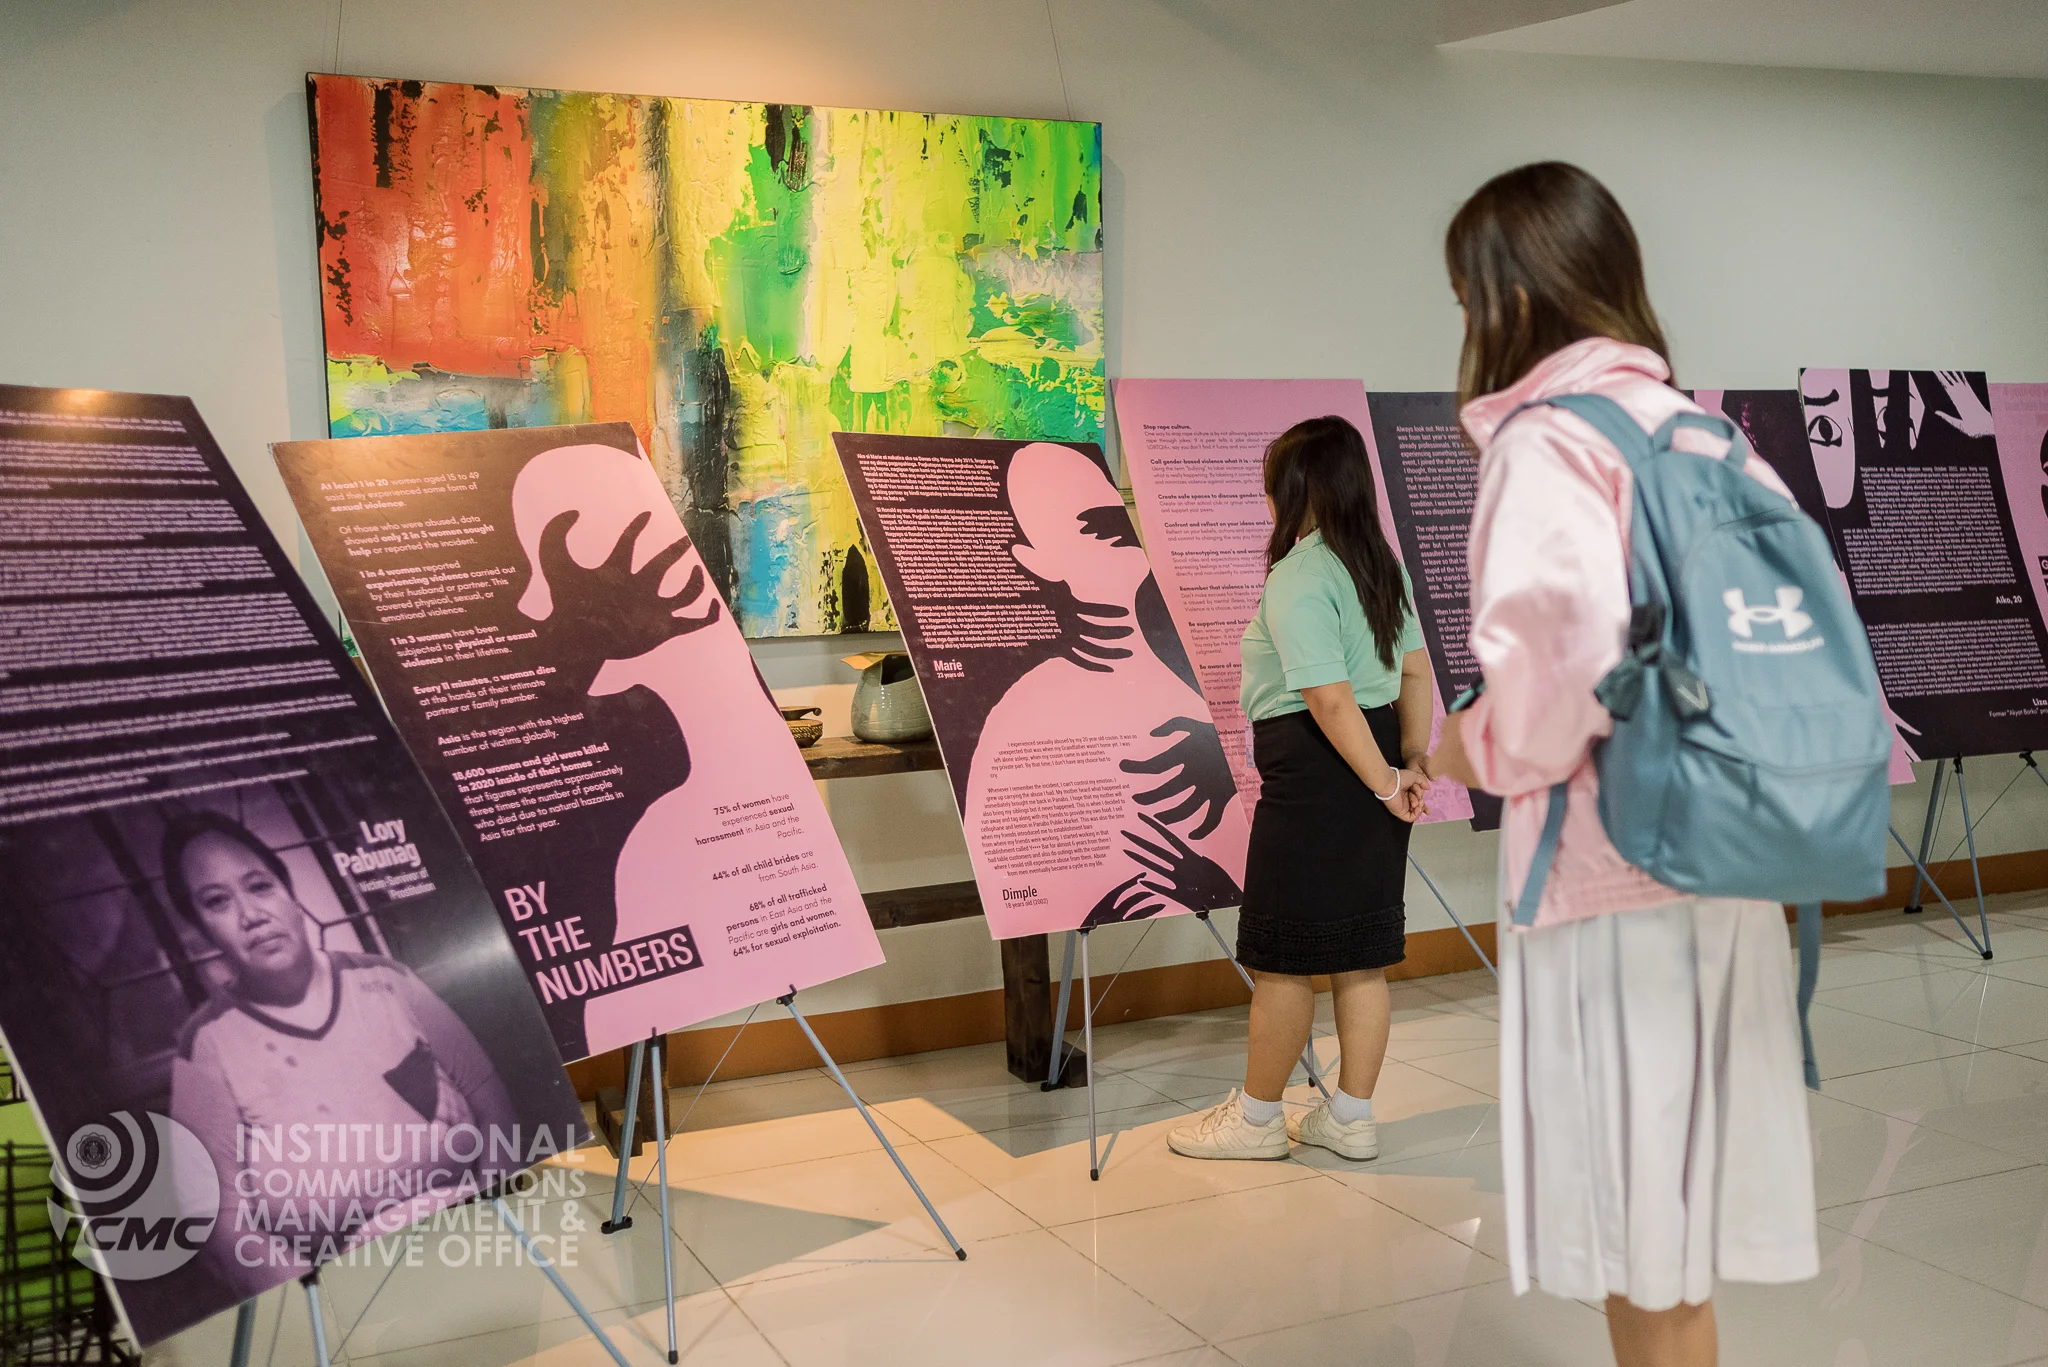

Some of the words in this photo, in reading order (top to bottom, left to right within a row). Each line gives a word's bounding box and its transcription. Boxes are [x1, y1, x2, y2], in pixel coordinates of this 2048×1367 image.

[366, 577, 429, 590] experiencing
[429, 573, 469, 582] violence
[470, 567, 501, 577] carried
[2013, 595, 2022, 603] 20
[397, 643, 442, 657] subjected
[454, 635, 494, 651] physical
[506, 629, 537, 641] sexual
[416, 633, 452, 642] women
[401, 657, 444, 668] violence
[454, 652, 475, 660] their
[475, 648, 512, 657] lifetime.
[934, 659, 962, 671] Marie
[413, 685, 441, 694] Every
[450, 678, 492, 688] minutes,
[500, 670, 535, 680] woman
[536, 666, 556, 675] dies
[452, 768, 485, 780] 18,600
[486, 763, 522, 774] women
[522, 756, 542, 767] and
[542, 752, 559, 765] girl
[559, 750, 583, 759] were
[582, 742, 609, 755] killed
[464, 794, 484, 804] that
[484, 789, 517, 802] figures
[517, 779, 564, 794] represents
[564, 765, 623, 785] approximately
[713, 806, 731, 815] 75%
[732, 802, 740, 811] of
[742, 798, 771, 809] women
[722, 809, 768, 827] experienced
[769, 802, 794, 816] sexual
[360, 819, 406, 843] Lory
[695, 828, 744, 845] harassment
[772, 817, 786, 827] and
[777, 827, 804, 839] Pacific.
[333, 844, 422, 877] Pabunag
[713, 871, 730, 880] 44%
[731, 867, 740, 876] of
[742, 864, 752, 873] all
[754, 858, 773, 870] child
[773, 854, 800, 865] brides
[758, 874, 776, 882] from
[778, 865, 799, 877] South
[801, 863, 818, 871] Asia.
[504, 881, 548, 922] BY
[750, 901, 766, 911] 68%
[767, 897, 775, 906] of
[777, 894, 787, 904] all
[788, 883, 827, 900] trafficked
[1002, 886, 1037, 901] Dimple
[726, 918, 759, 934] persons
[769, 909, 785, 920] East
[788, 906, 803, 914] Asia
[804, 899, 818, 910] and
[728, 931, 754, 944] Pacific
[770, 922, 788, 935] girls
[790, 915, 805, 927] and
[518, 916, 591, 961] THE
[733, 946, 750, 956] 64%
[751, 943, 762, 951] for
[765, 933, 791, 948] sexual
[793, 922, 841, 940] exploitation.
[536, 933, 694, 1004] NUMBERS
